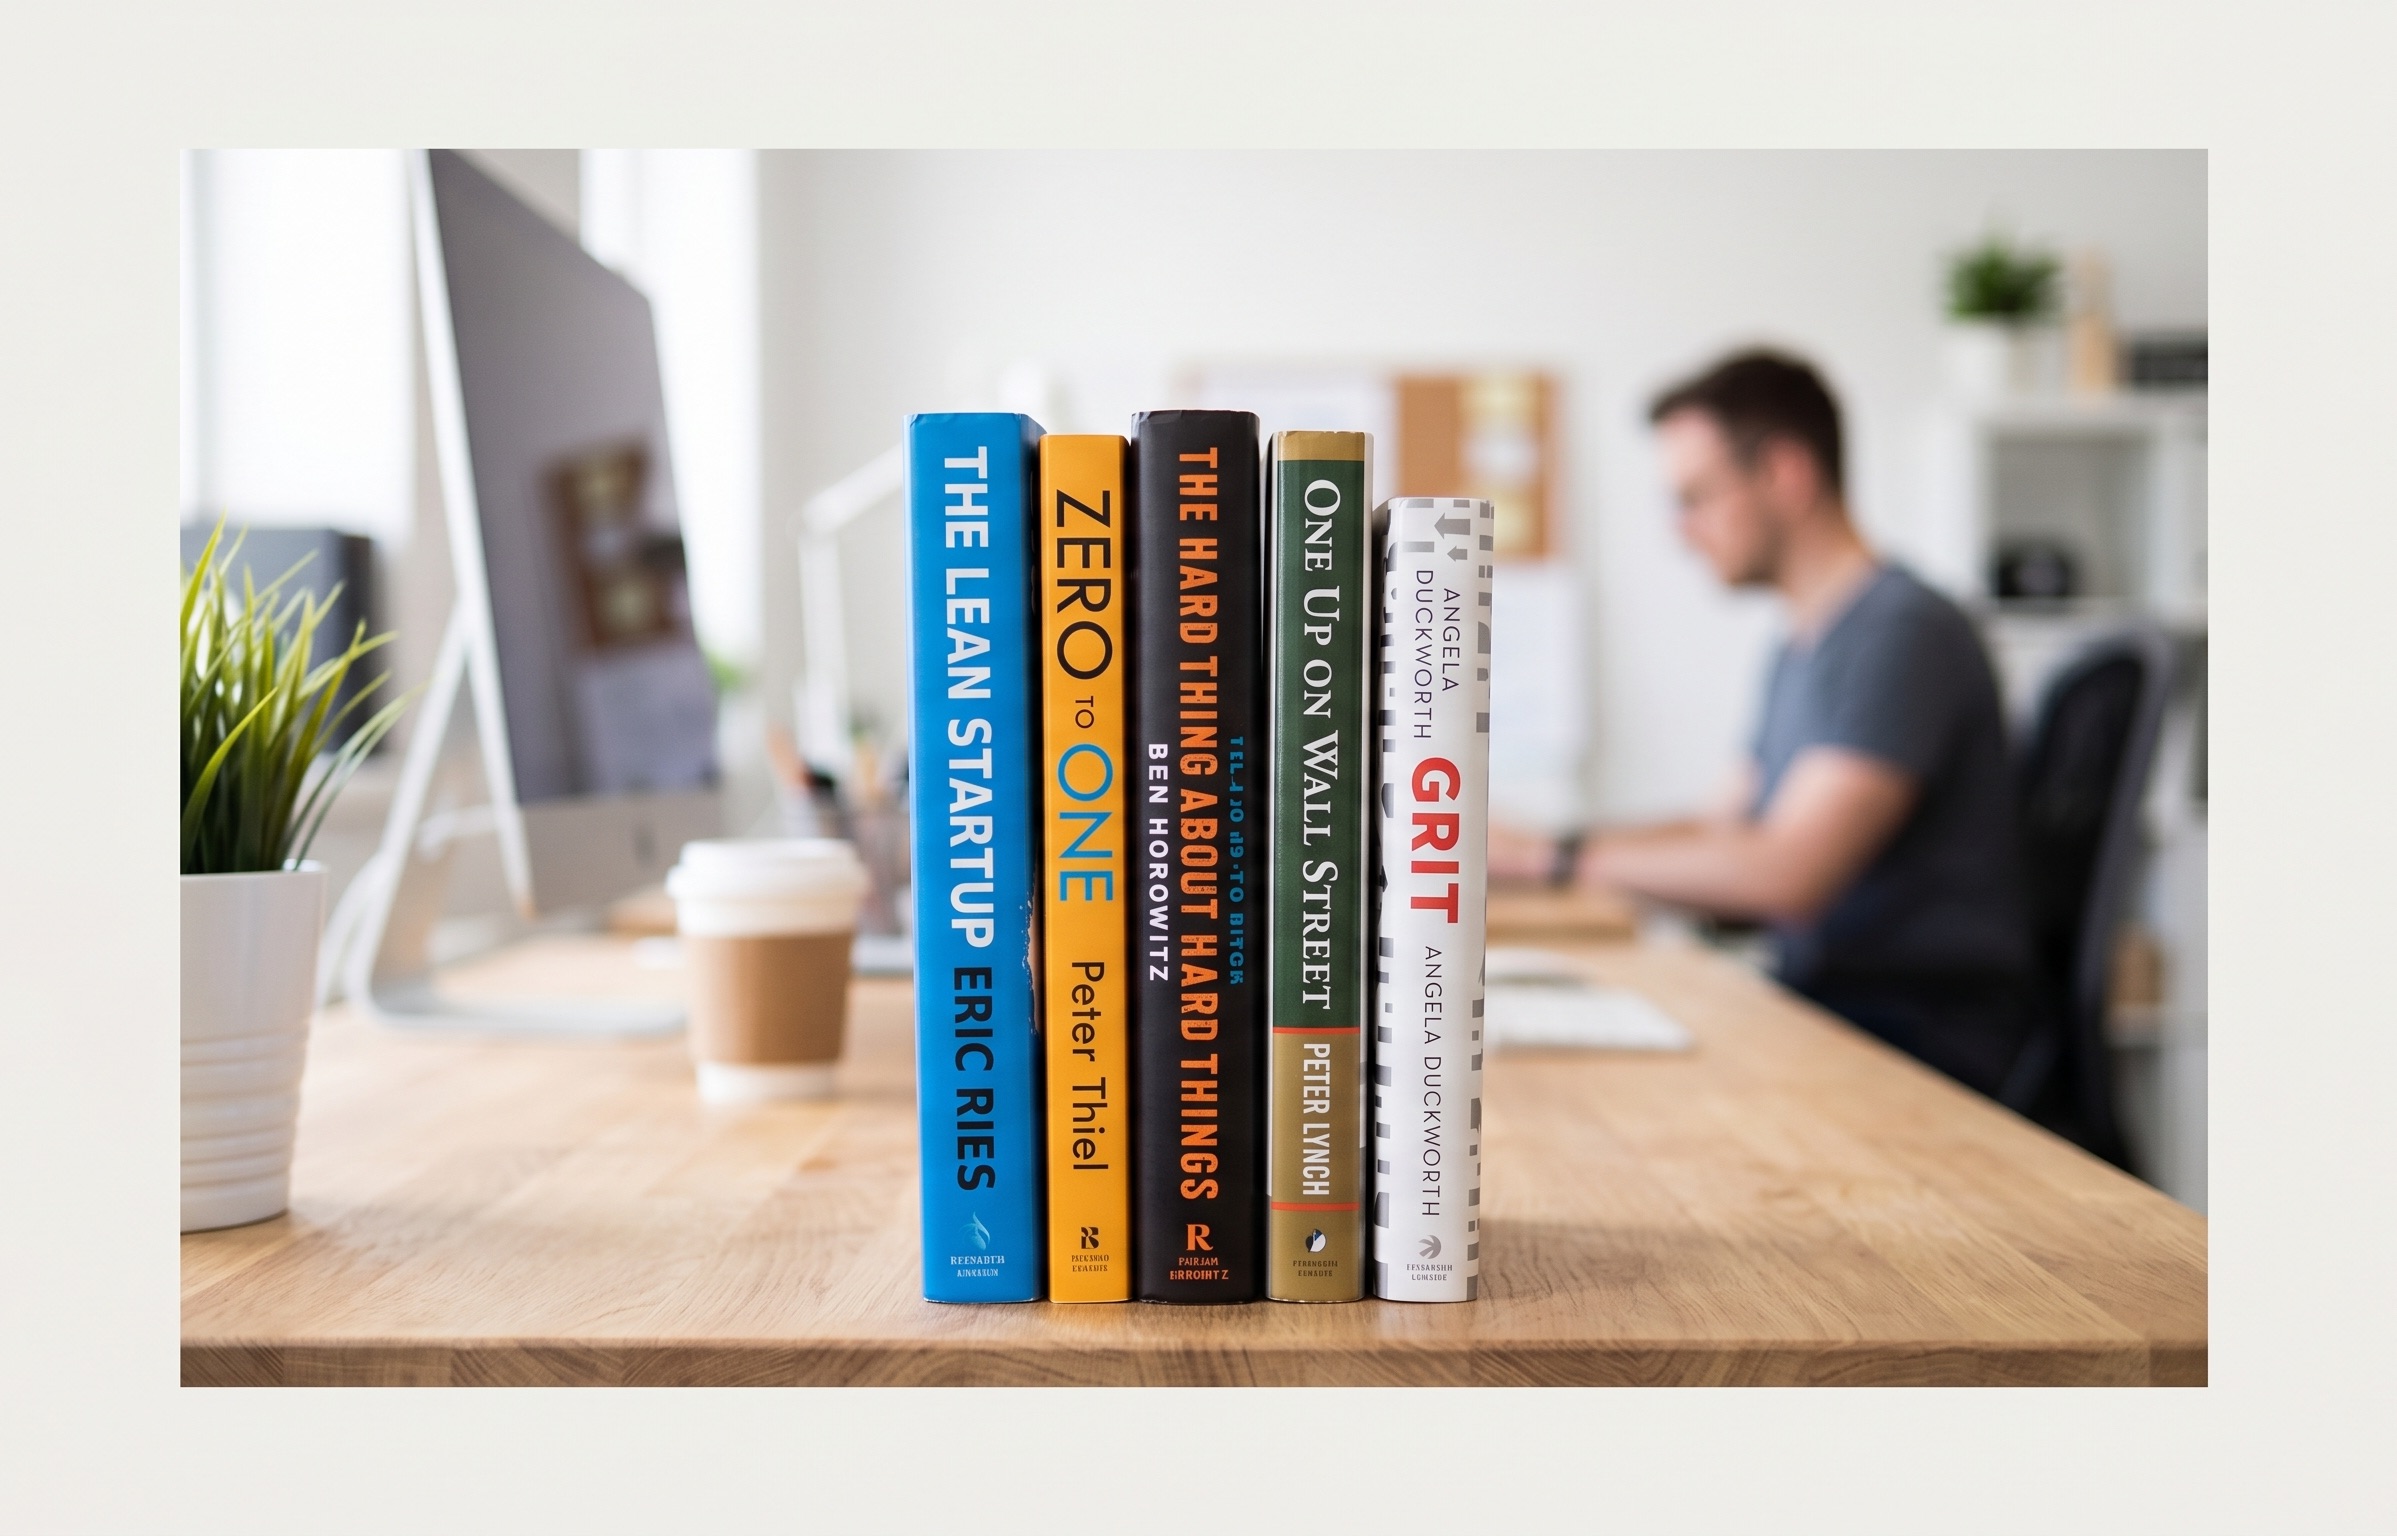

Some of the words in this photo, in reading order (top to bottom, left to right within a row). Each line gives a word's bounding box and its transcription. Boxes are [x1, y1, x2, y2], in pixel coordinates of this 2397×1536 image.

[945, 446, 988, 548] THE
[1179, 447, 1217, 520] THE
[1305, 480, 1340, 571] ONE
[946, 568, 991, 699] LEAN
[1057, 490, 1113, 679] ZERO
[1179, 538, 1217, 643] HARD
[1304, 586, 1339, 645] UP
[1304, 660, 1332, 717] ON
[1414, 570, 1433, 738] DUCKWORTH
[1442, 589, 1460, 691] ANGELA
[1075, 696, 1094, 729] TO
[1180, 656, 1217, 775] THING
[1057, 743, 1113, 901] ONE
[1149, 744, 1168, 803] BEN
[1303, 730, 1338, 845] WALL
[948, 719, 994, 947] STARTUP
[1180, 789, 1218, 919] ABOUT
[1411, 758, 1461, 923] GRIT
[1149, 819, 1168, 980] HOROWITZ
[1303, 861, 1338, 1009] STREET
[954, 967, 994, 1071] ERIC
[1072, 962, 1104, 1061] Peter
[1181, 935, 1218, 1040] HARD
[1425, 947, 1442, 1044] ANGELA
[1073, 1077, 1108, 1169] Thiel
[1181, 1054, 1218, 1199] THINGS
[1303, 1044, 1330, 1113] PETER
[957, 1088, 996, 1190] RIES
[1303, 1123, 1330, 1194] LYNCH
[1423, 1057, 1441, 1215] DUCKWORTH
[1187, 1224, 1212, 1250] R
